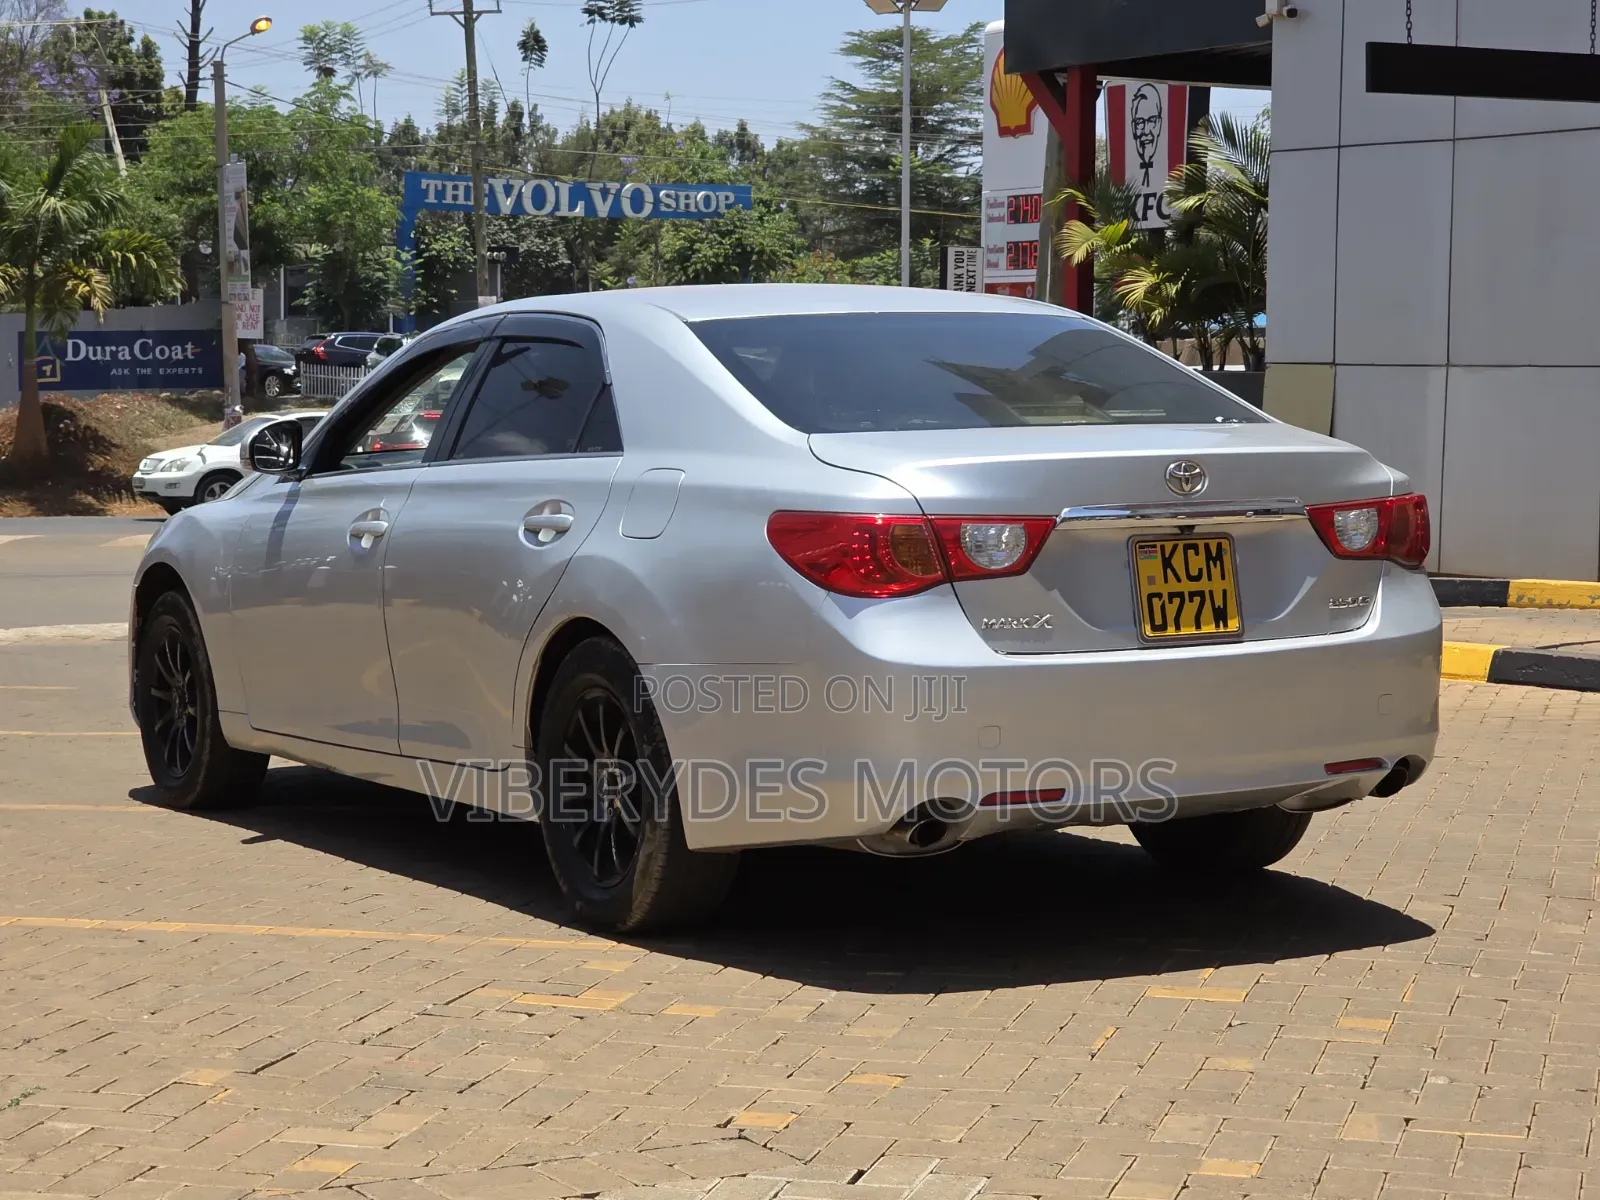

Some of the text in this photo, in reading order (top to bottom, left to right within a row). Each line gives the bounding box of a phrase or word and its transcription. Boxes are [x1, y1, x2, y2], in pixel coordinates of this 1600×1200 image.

[488, 179, 654, 218] VOLVO
[660, 190, 735, 213] SHOP
[1008, 195, 1043, 223] 214.0
[954, 250, 965, 270] YOU
[966, 249, 977, 292] NEXT TIME
[110, 367, 203, 376] ASK THE EXPERTS
[1160, 542, 1226, 584] KCM
[1146, 588, 1228, 632] 077W
